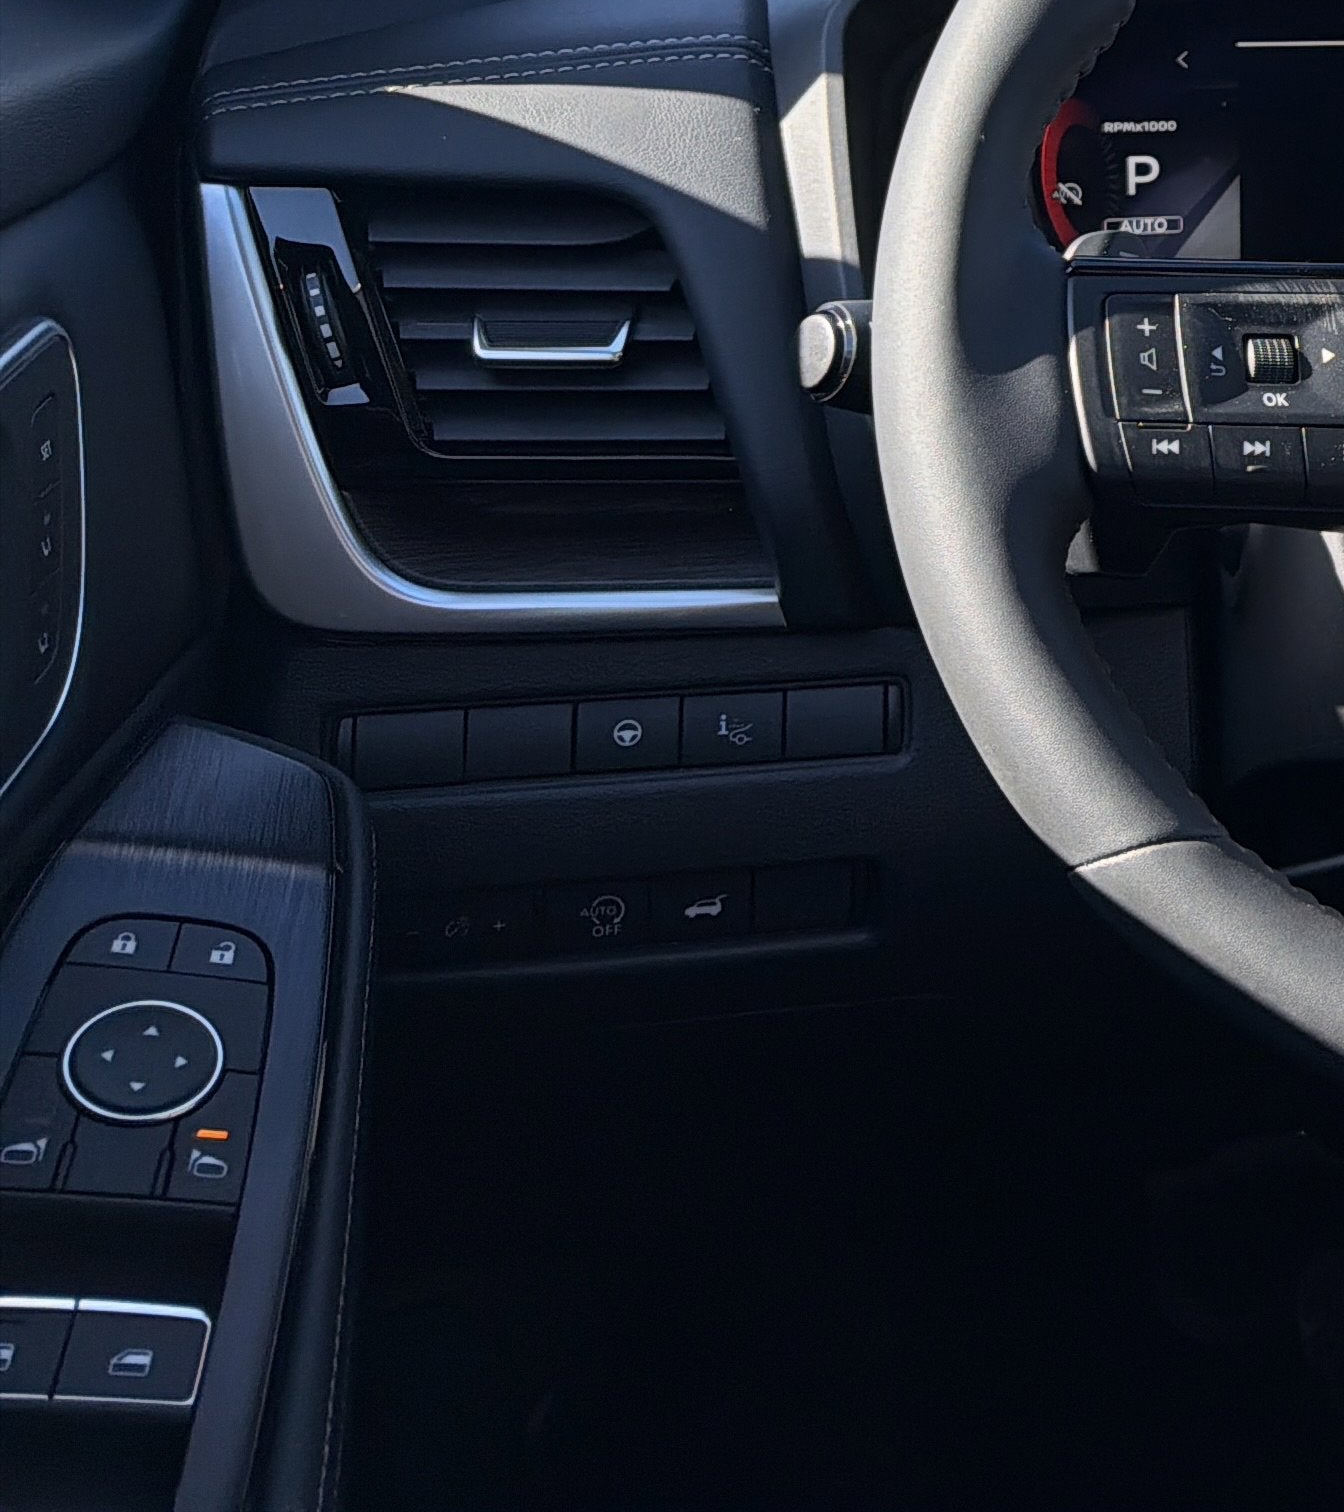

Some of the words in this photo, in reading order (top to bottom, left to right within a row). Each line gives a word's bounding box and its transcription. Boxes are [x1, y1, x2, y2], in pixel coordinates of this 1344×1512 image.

[1103, 120, 1178, 134] RPMx1000
[1125, 155, 1160, 196] P
[1119, 217, 1169, 234] AUTO
[1262, 392, 1290, 408] OK
[592, 923, 623, 938] OFF
